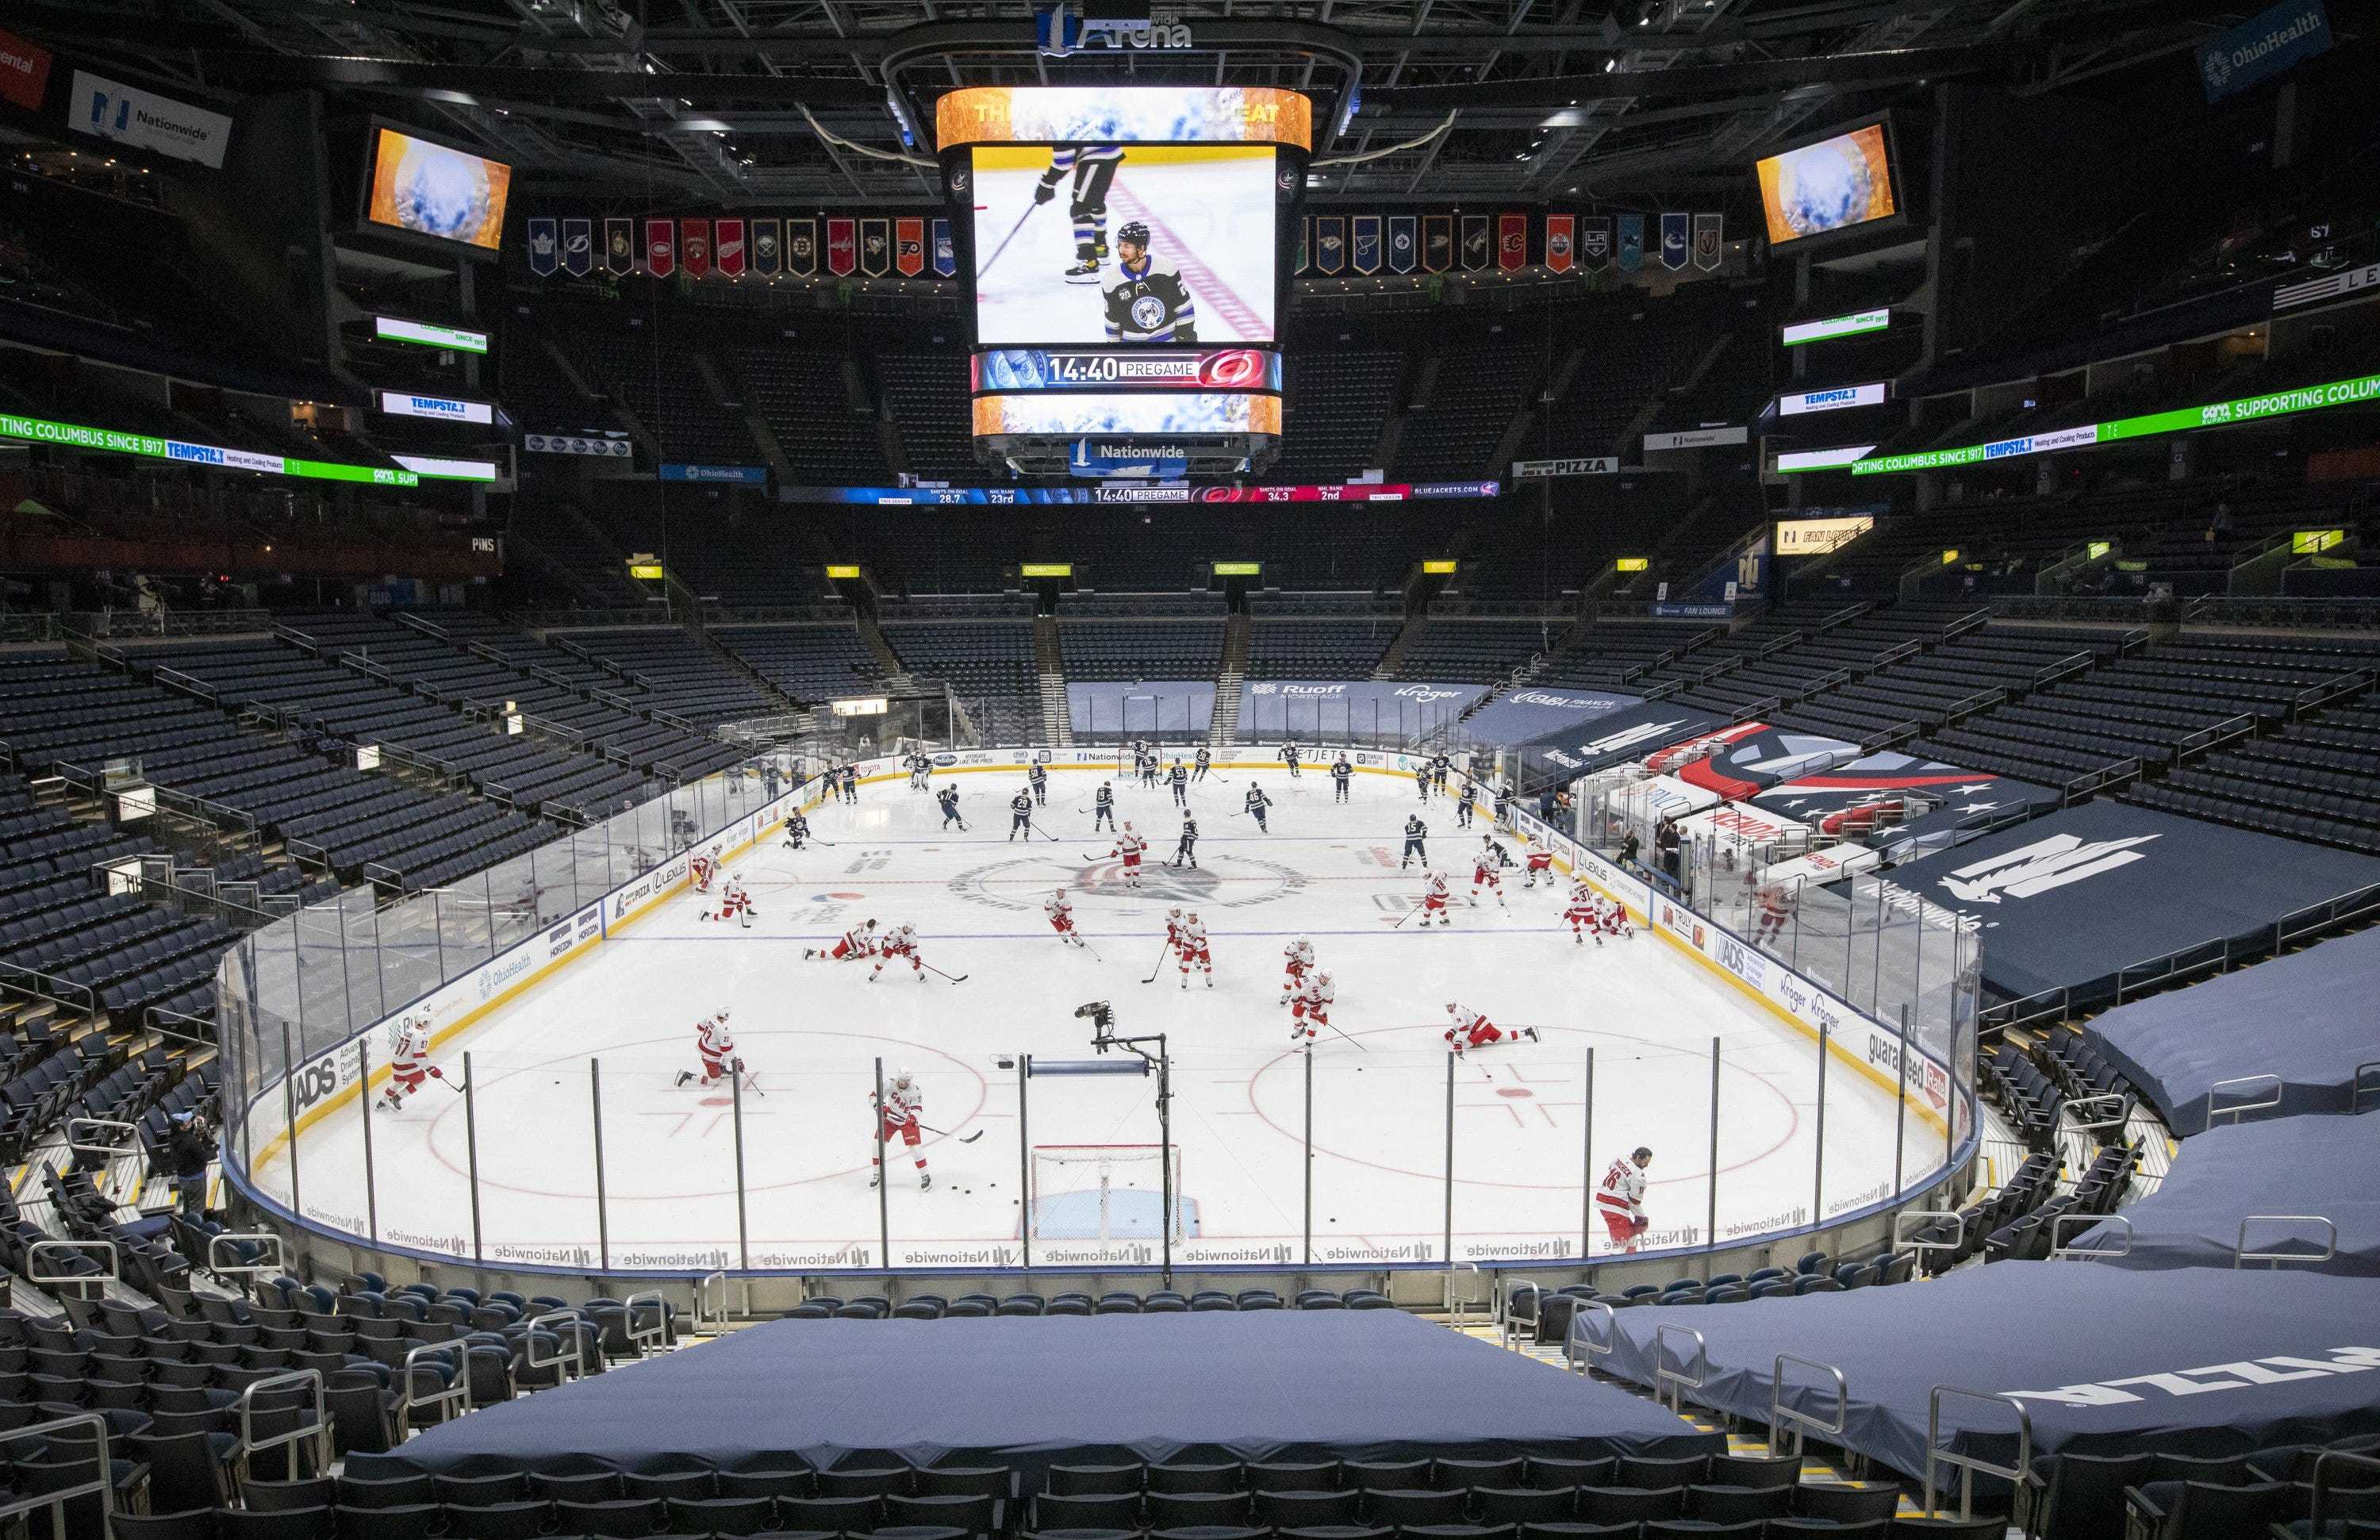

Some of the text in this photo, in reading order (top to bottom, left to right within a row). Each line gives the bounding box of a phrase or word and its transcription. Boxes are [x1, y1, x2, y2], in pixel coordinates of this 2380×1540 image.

[1077, 24, 1192, 48] Arena
[2232, 11, 2321, 67] OhioHealth
[136, 109, 208, 141] Nationwide
[1049, 357, 1118, 382] 14:40
[1126, 363, 1194, 375] PREGAME
[2236, 388, 2323, 418] SUPPORTING
[36, 423, 104, 446] COLUMBUS
[106, 433, 139, 451] SINCE
[141, 439, 163, 453] 1917
[2034, 438, 2049, 447] Heating
[2059, 435, 2075, 445] Cooling
[1100, 445, 1184, 458] Nationwide
[1886, 453, 1937, 470] COLUMBUS
[1939, 451, 1966, 463] SINCE
[1967, 448, 1983, 461] 1917
[226, 455, 242, 465] Heating
[251, 457, 266, 468] Cooling
[267, 459, 282, 469] Products
[1555, 459, 1607, 474] PIZZA
[701, 469, 743, 478] OhioHealth
[939, 494, 960, 503] 28.7
[991, 494, 1014, 503] 23rd
[1095, 489, 1132, 502] 14:40
[1269, 492, 1288, 501] 34.3
[1322, 490, 1339, 501] 2nd
[1283, 685, 1347, 694] Ruoff
[1395, 685, 1463, 702] Kroger
[1526, 695, 1570, 706] KEMBA
[1017, 798, 1029, 808] 29
[1098, 790, 1105, 801] 19
[1584, 859, 1608, 881] LEXUS
[1803, 853, 1841, 870] KENDA
[661, 862, 686, 884] LEXUS
[635, 883, 651, 901] PIZZA
[1579, 889, 1591, 902] 37
[1675, 908, 1691, 927] TRULY
[578, 924, 599, 942] HORIZON
[550, 939, 573, 959] HORIZON
[1722, 939, 1745, 974] ADS
[493, 953, 532, 986] OhioHealth
[1780, 974, 1806, 1012] Kroger
[1811, 993, 1840, 1035] Kroger
[1869, 1034, 1924, 1089] guarateed
[294, 1058, 336, 1117] ADS
[1928, 1068, 1945, 1096] Rate
[1603, 1167, 1622, 1190] 16
